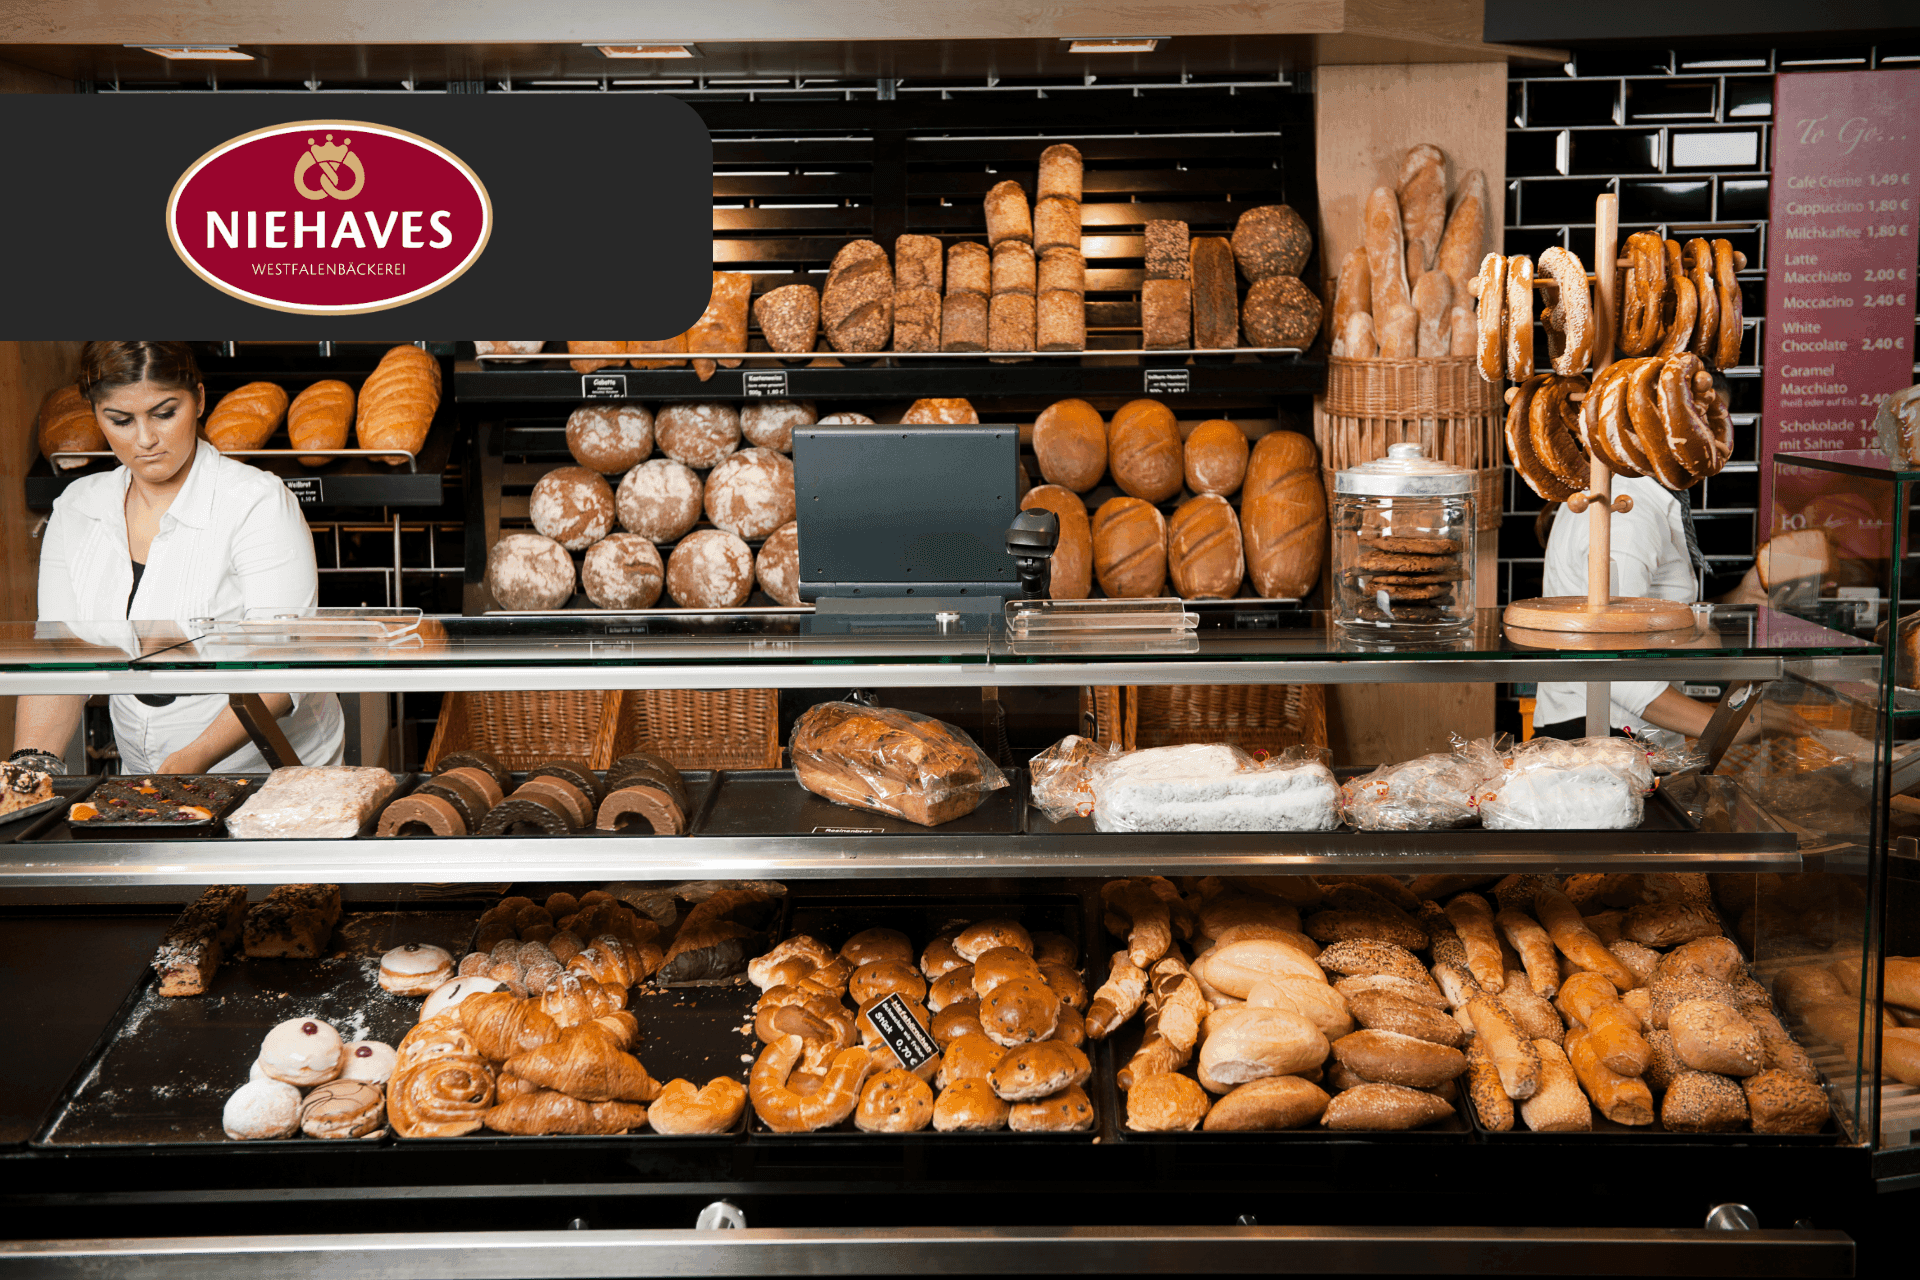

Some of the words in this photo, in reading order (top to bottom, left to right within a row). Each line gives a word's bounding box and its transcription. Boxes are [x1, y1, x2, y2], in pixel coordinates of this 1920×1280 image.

[1796, 114, 1828, 144] To
[1869, 174, 1898, 187] 1,49
[1901, 172, 1910, 185] €
[1786, 201, 1864, 217] Cappuccino
[1868, 200, 1898, 213] 1,80
[1900, 199, 1909, 211] €
[1786, 225, 1861, 239] Milchkaffee
[1867, 225, 1897, 238] 1,80
[1899, 224, 1909, 236] €
[1785, 254, 1818, 266] Latte
[1784, 270, 1852, 283] Macchiato
[1864, 269, 1895, 282] 2,00
[1897, 268, 1907, 280] €
[1783, 296, 1854, 309] Moccacino
[1863, 294, 1894, 308] 2,40
[1896, 294, 1906, 306] €
[1782, 322, 1821, 334] White
[1781, 338, 1848, 353] Chocolate
[1862, 338, 1893, 351] 2,40
[1894, 337, 1904, 349] €
[1781, 363, 1835, 377] Caramel
[1780, 382, 1848, 395] Macchiato
[1780, 419, 1855, 433] Schokolade
[1779, 438, 1801, 450] mit
[1804, 437, 1844, 450] Sahne
[875, 1011, 893, 1034] Stück
[896, 1038, 912, 1058] 0,70
[910, 1057, 918, 1066] €
